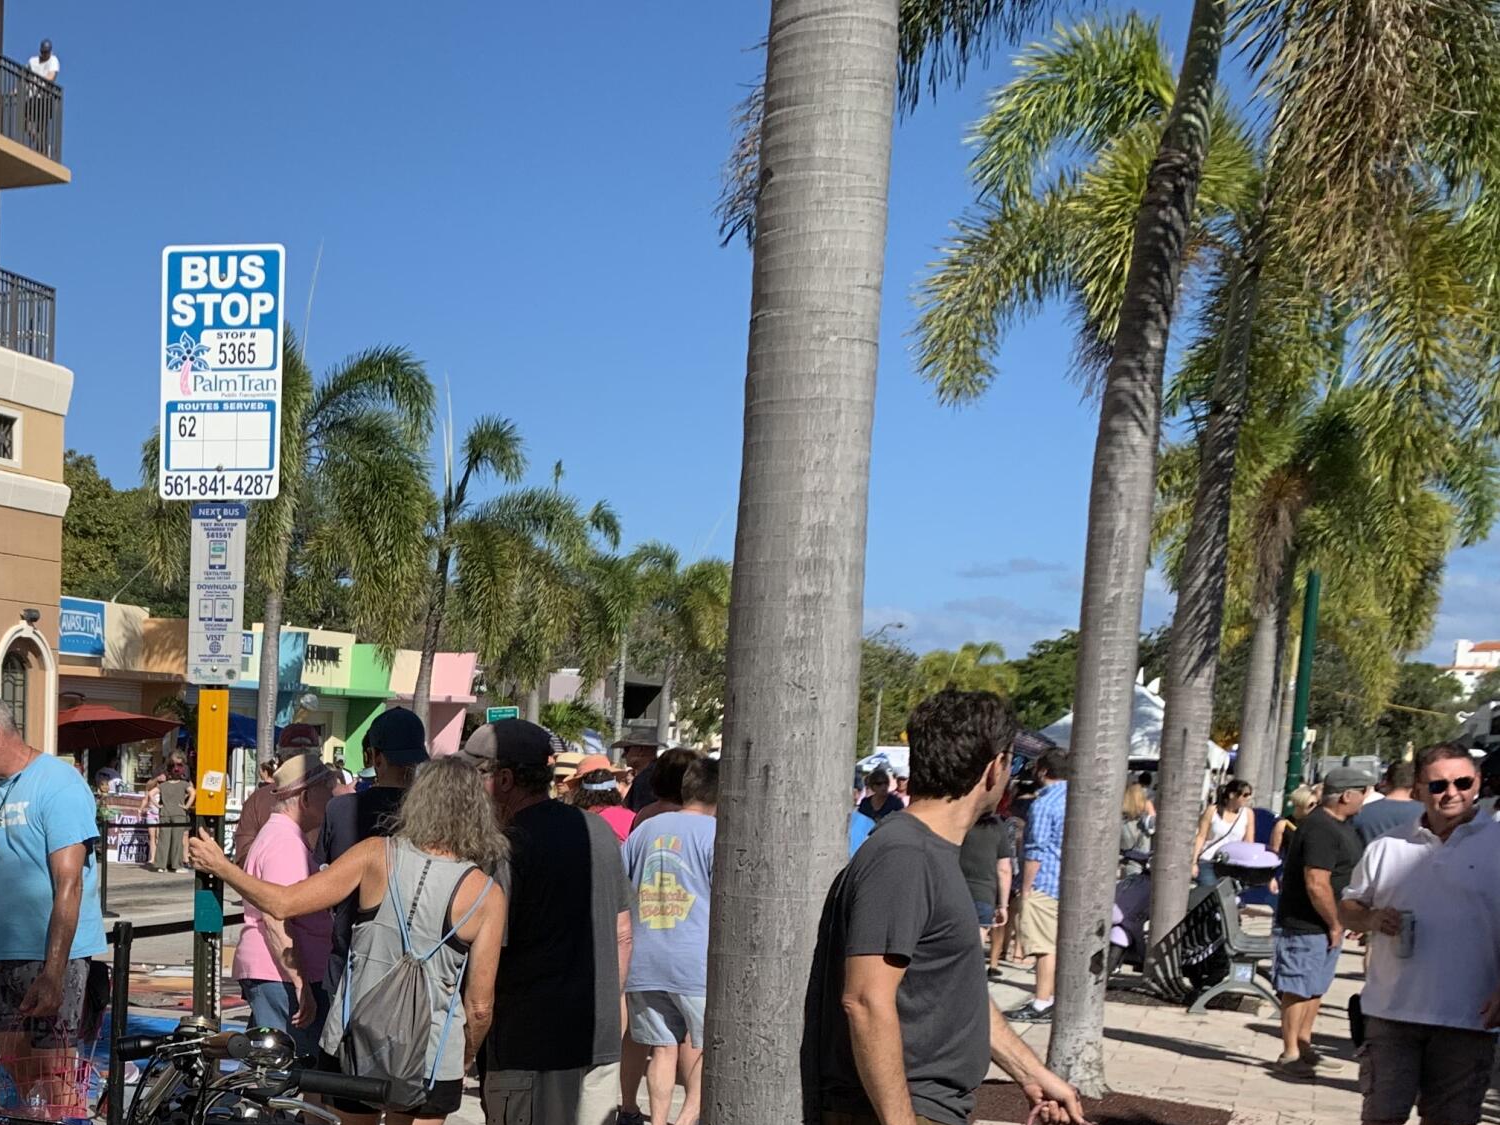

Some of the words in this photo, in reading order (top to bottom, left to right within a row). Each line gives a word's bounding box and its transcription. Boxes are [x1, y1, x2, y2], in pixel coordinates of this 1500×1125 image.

[181, 255, 265, 289] BUS
[171, 292, 275, 327] STOP
[218, 342, 256, 365] 5365
[193, 374, 277, 393] PalmTran
[177, 403, 219, 411] ROUTES
[223, 402, 268, 411] SERVED:
[178, 416, 197, 438] 62
[164, 474, 274, 497] 561-841-4287
[198, 508, 221, 516] NEXT
[223, 508, 240, 516] BUS
[196, 583, 238, 591] DOWNLOAD
[60, 609, 104, 643] AVASUTRA
[205, 634, 225, 642] VISIT
